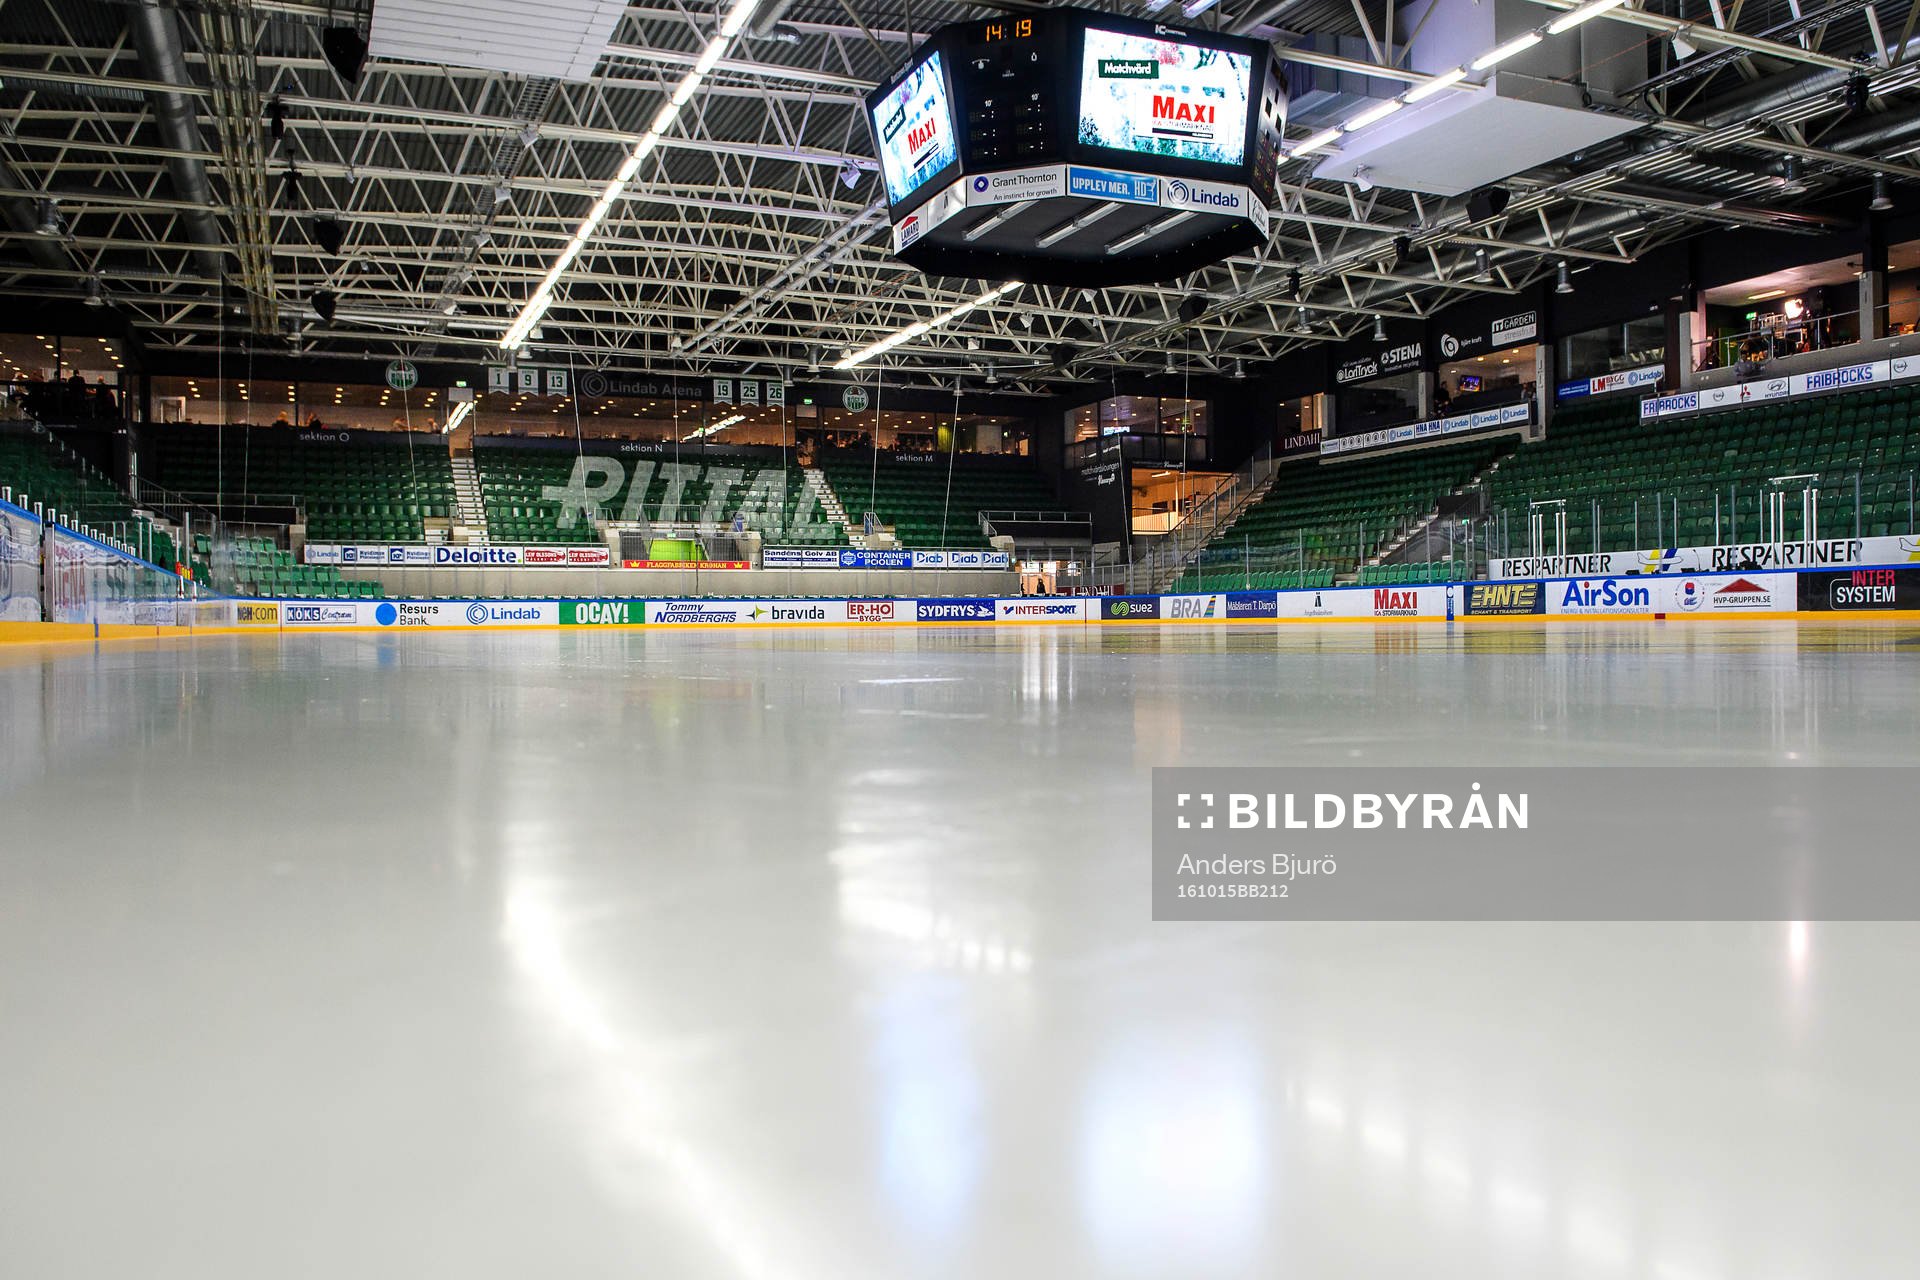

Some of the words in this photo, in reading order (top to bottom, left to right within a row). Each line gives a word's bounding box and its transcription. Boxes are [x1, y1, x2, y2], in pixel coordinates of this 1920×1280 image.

[1104, 62, 1151, 74] Matchvärd
[1152, 95, 1215, 123] MAXI
[907, 117, 936, 155] MAXI
[992, 177, 1017, 188] Grant
[1018, 173, 1057, 185] Thornton
[1073, 177, 1107, 192] UPPLEV
[1109, 182, 1130, 195] MER.
[1004, 192, 1025, 200] instinct
[1026, 190, 1035, 198] for
[1035, 188, 1058, 198] growth
[1192, 188, 1239, 208] Lindab
[1504, 313, 1534, 329] GARDEN
[1389, 343, 1421, 363] STENA
[524, 375, 531, 386] 9
[551, 376, 563, 387] 13
[1639, 371, 1662, 381] Lindab
[609, 380, 658, 395] Lindab
[662, 383, 703, 397] Arena
[1592, 378, 1606, 392] LM
[1606, 373, 1625, 384] BYGG
[717, 384, 728, 396] 19
[743, 386, 756, 398] 25
[769, 387, 782, 399] 26
[1480, 414, 1499, 423] Lindab
[1510, 409, 1527, 418] Lindab
[1451, 419, 1469, 428] Lindab
[300, 432, 336, 442] sektion
[339, 432, 350, 442] O
[1396, 429, 1413, 438] Lindab
[620, 443, 652, 452] sektion
[654, 444, 663, 452] N
[895, 454, 923, 462] sektion
[925, 455, 933, 463] M
[857, 552, 911, 560] CONTAINER
[916, 552, 943, 564] Diab
[952, 552, 978, 564] Diab
[982, 552, 1009, 564] Diab
[1712, 540, 1863, 568] RESPARTNER
[1502, 554, 1611, 577] RESPARTNER
[1852, 569, 1895, 586] INTER
[1374, 588, 1418, 610] MAXI
[1562, 580, 1649, 607] AirSon
[1836, 586, 1896, 604] SYSTEM
[1713, 596, 1771, 604] HVP-GRUPPEN.SE
[287, 606, 320, 621] KÖKS
[400, 603, 438, 614] Resurs
[491, 607, 541, 620] Lindab
[575, 602, 628, 624] OCAY!
[665, 602, 705, 613] Tommy
[772, 605, 825, 620] bravida
[849, 603, 891, 615] ER-HO
[918, 604, 975, 617] SYDFRYS
[1016, 605, 1076, 615] INTERSPORT
[1170, 598, 1202, 618] BRA
[400, 615, 428, 626] Bank
[654, 611, 737, 623] NORDBERGHS
